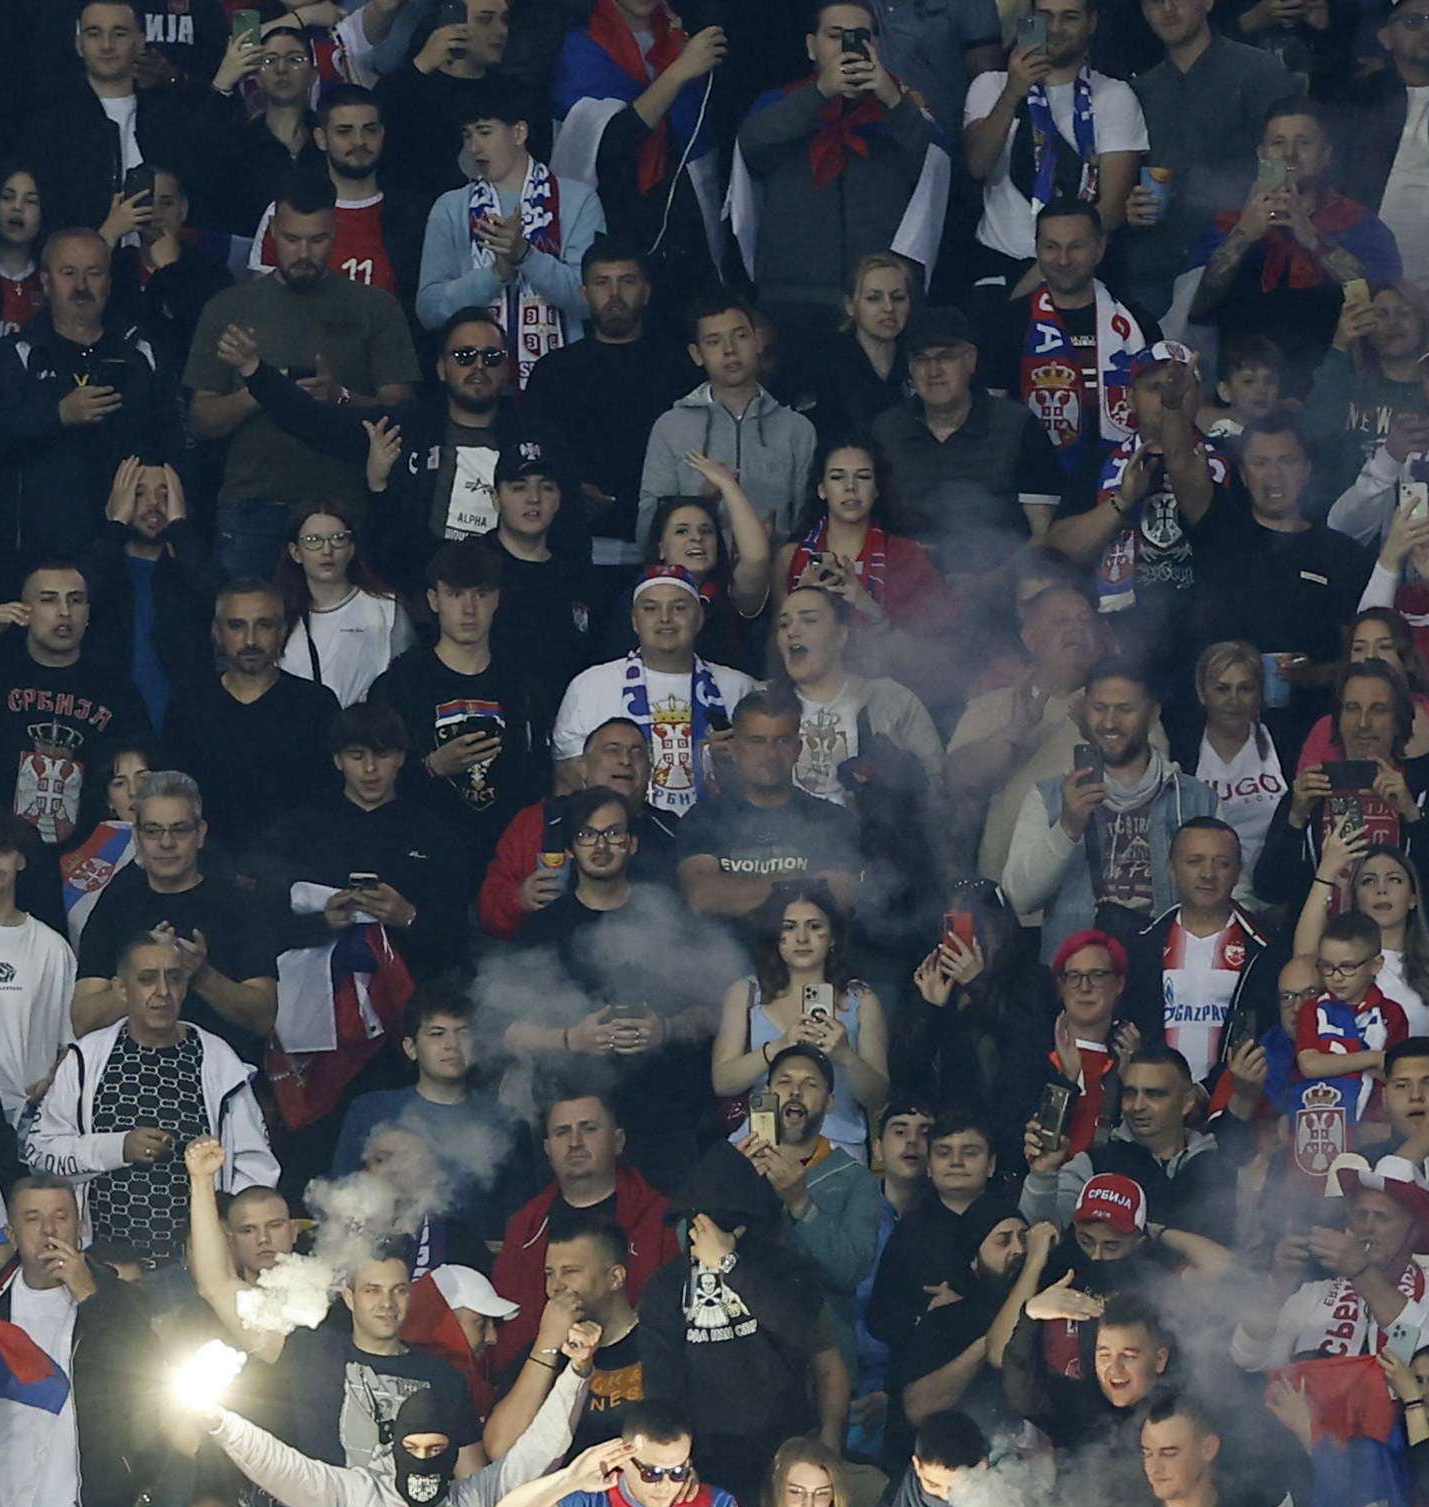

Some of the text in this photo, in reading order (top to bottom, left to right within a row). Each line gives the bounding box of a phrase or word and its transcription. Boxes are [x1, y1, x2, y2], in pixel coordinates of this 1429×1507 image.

[145, 13, 194, 45] ИЈА
[8, 688, 113, 733] СРБИЈА
[721, 857, 809, 873] EVOLUTION
[1088, 1188, 1133, 1210] СРБИЈА
